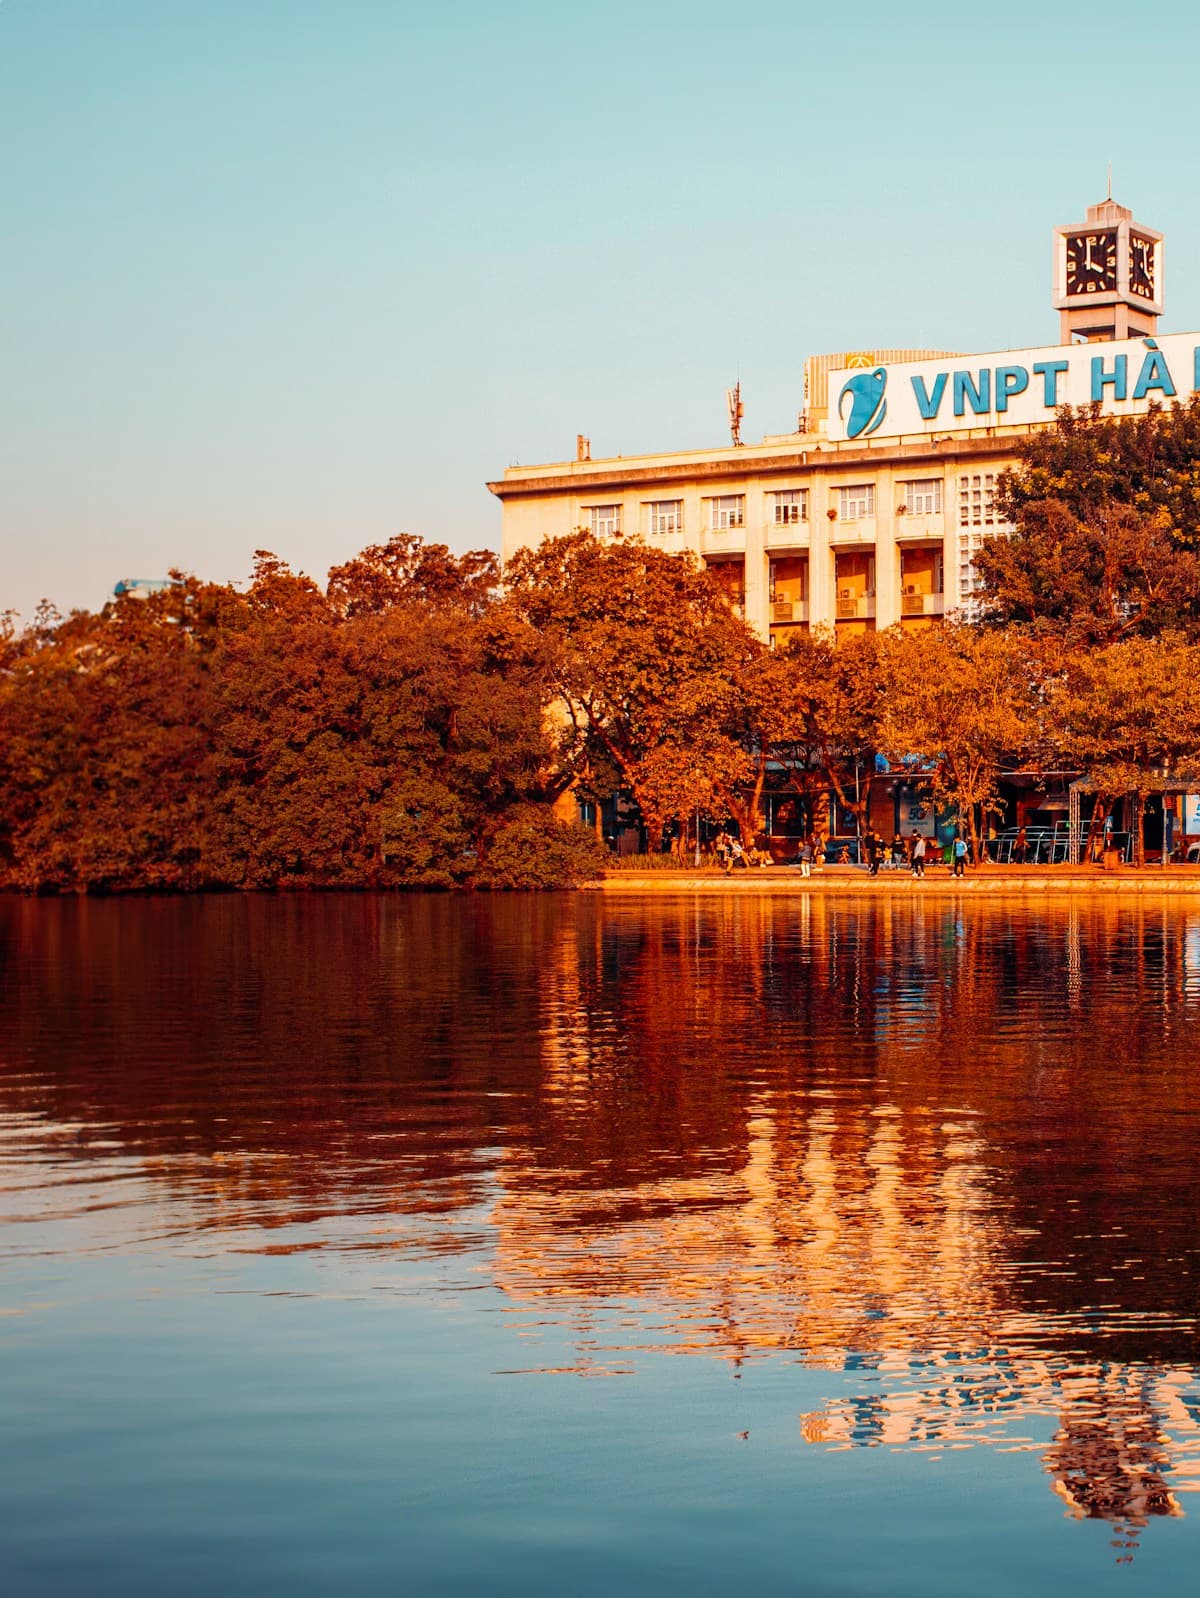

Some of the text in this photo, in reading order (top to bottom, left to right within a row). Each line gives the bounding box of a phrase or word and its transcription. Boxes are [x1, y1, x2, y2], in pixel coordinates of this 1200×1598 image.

[1067, 261, 1076, 272] 9
[1107, 257, 1116, 267] 3
[1086, 281, 1096, 292] 6
[911, 360, 1069, 419] VNPT
[1090, 338, 1176, 402] HÀ
